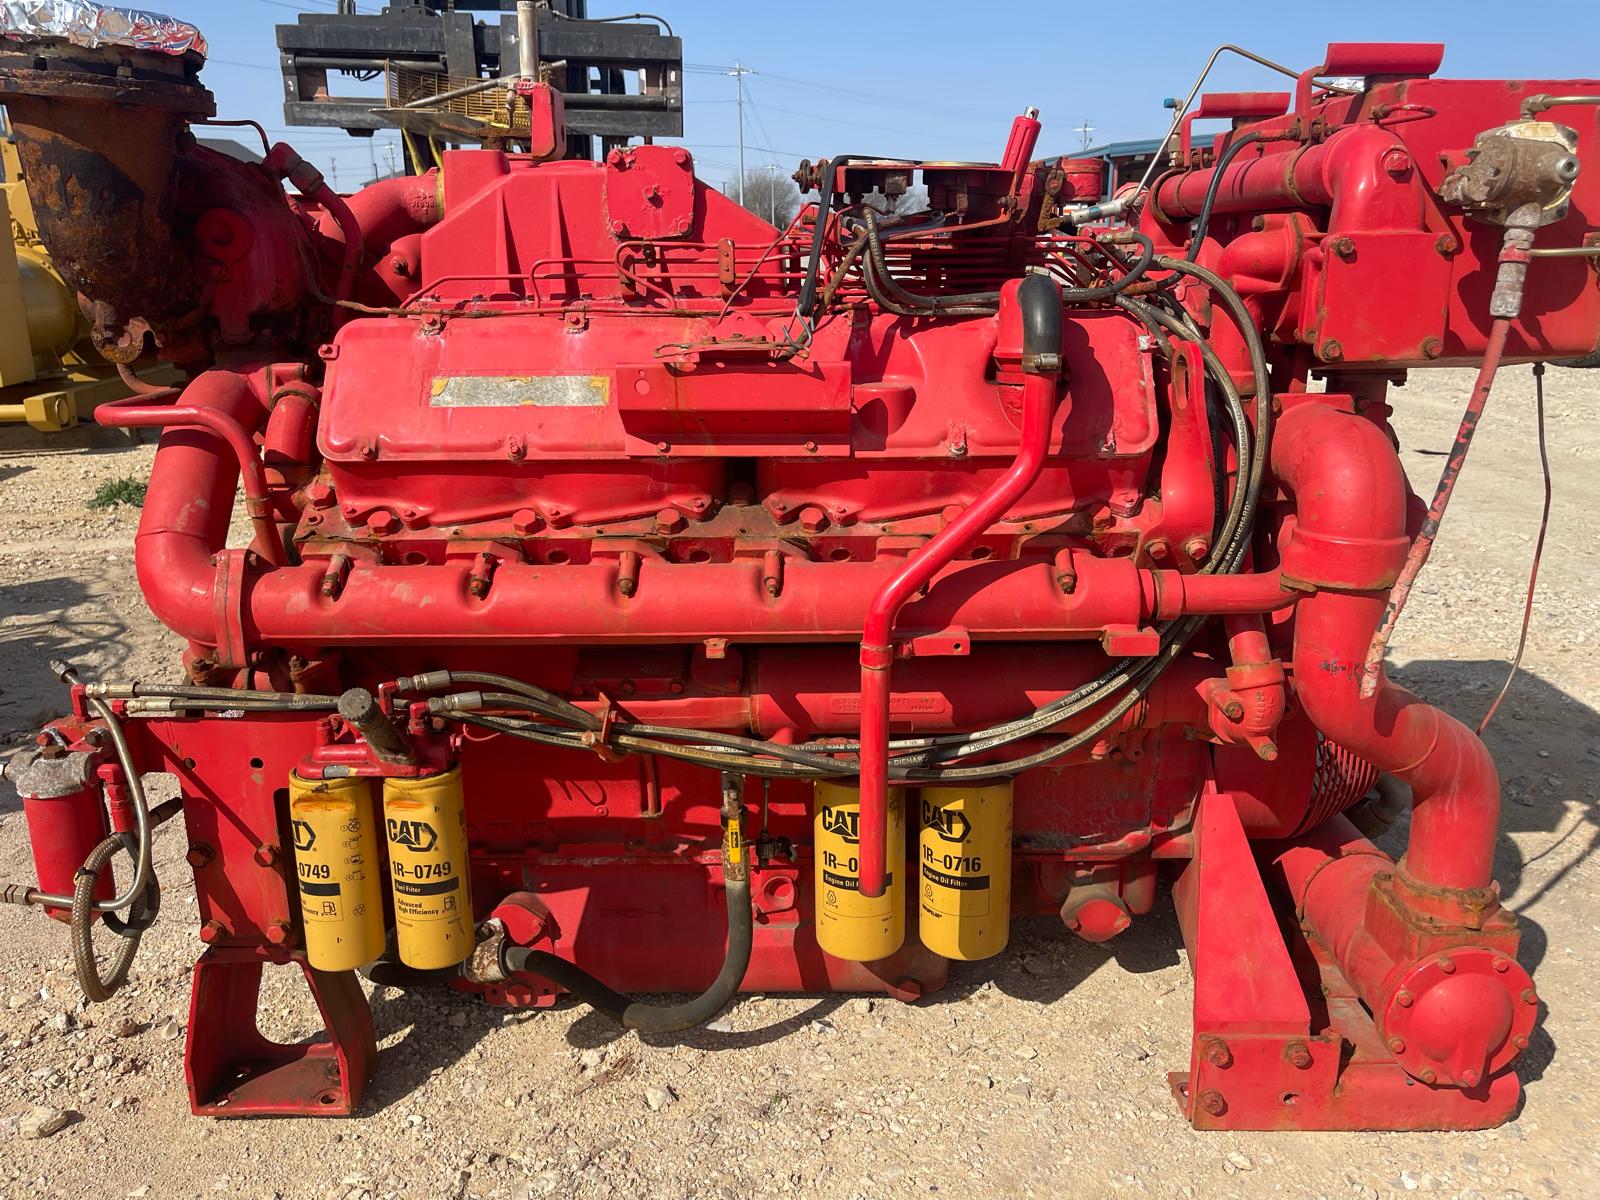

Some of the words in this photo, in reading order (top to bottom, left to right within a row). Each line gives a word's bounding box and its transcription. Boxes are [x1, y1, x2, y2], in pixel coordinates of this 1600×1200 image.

[869, 232, 886, 276] DIEHARD
[1233, 502, 1252, 541] DIEHARD
[1060, 690, 1081, 707] T3000
[1099, 658, 1131, 685] DIEHARD
[893, 755, 929, 767] DIEHARD
[822, 805, 860, 838] CAT
[923, 799, 957, 836] CAT
[387, 818, 423, 846] CAT
[823, 850, 859, 873] 1R-0
[922, 844, 982, 873] 1R-0716
[298, 861, 331, 879] 0749
[392, 861, 452, 879] 1R-0749
[923, 867, 940, 881] Engine
[940, 876, 950, 885] Oil
[950, 879, 968, 887] Filter
[405, 885, 421, 893] Filter
[825, 874, 844, 886] Engine
[845, 880, 855, 888] Oil
[397, 897, 423, 909] Advanced
[398, 906, 409, 914] High
